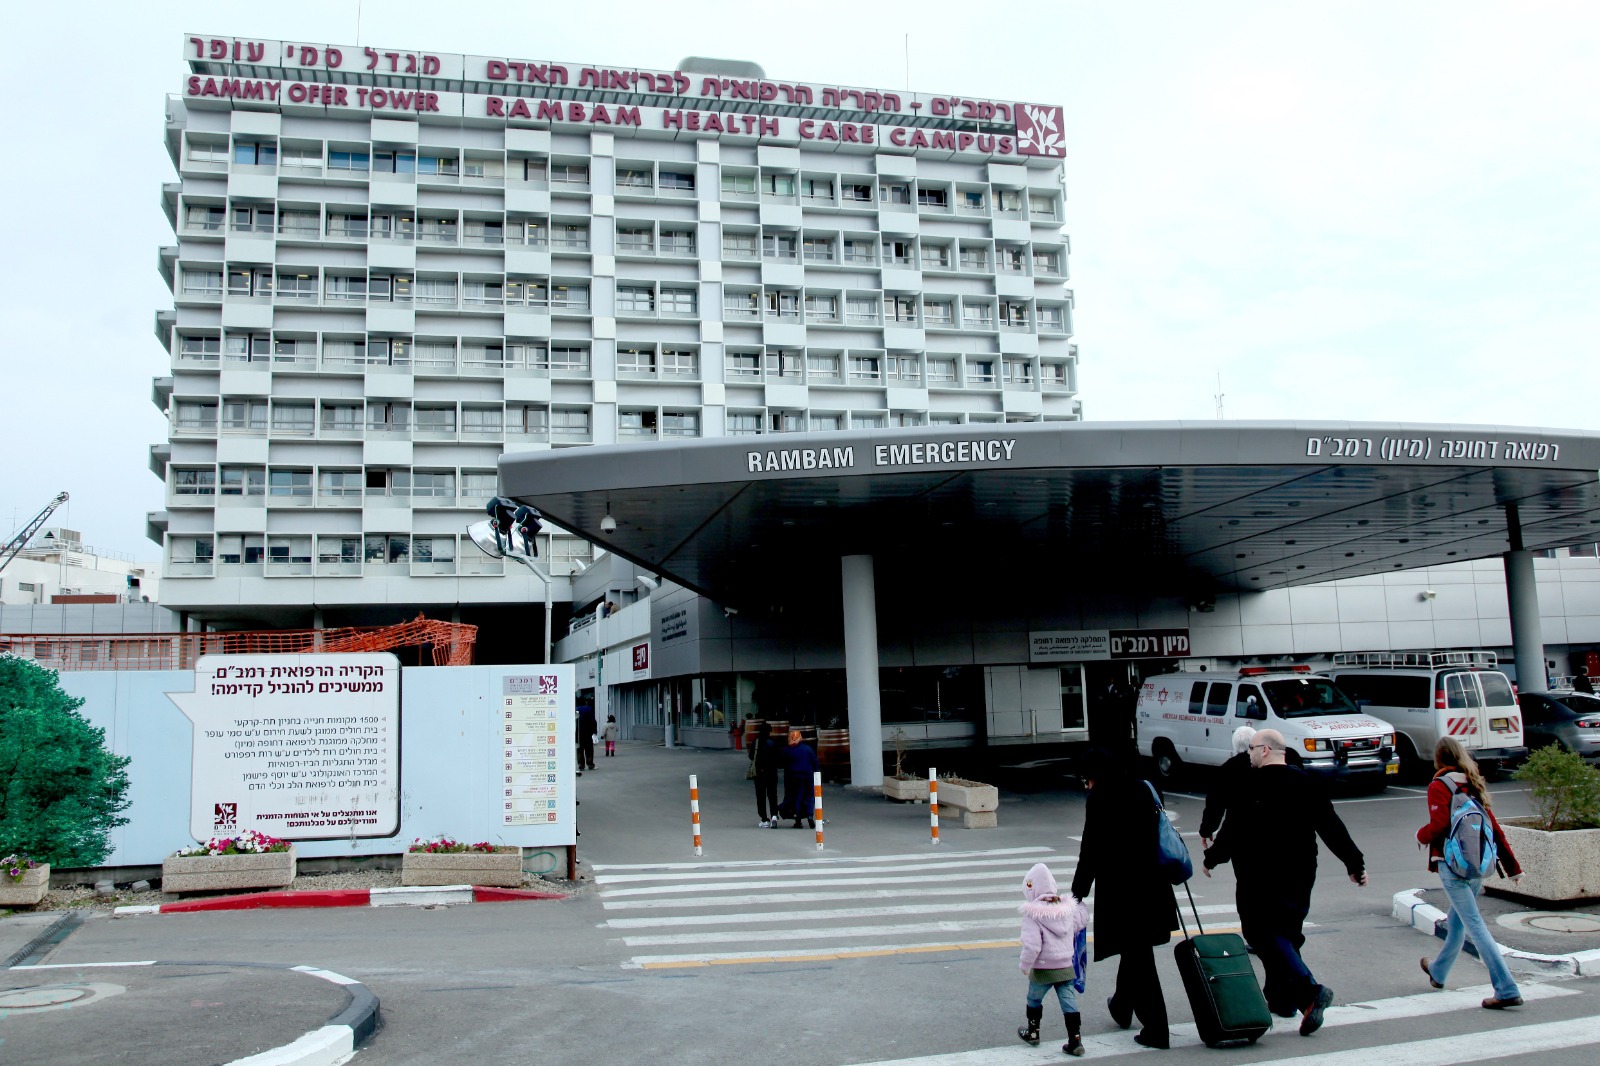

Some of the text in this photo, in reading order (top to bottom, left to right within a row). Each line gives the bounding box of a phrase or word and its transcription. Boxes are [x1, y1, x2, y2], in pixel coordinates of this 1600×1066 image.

[190, 38, 441, 75] מגדל סמי עופר
[487, 60, 568, 85] האדם
[579, 68, 690, 94] לבריאות
[188, 76, 440, 111] SAMMY OFER TOWER
[701, 76, 813, 105] הרפואית
[822, 87, 901, 113] הקריה
[931, 96, 1012, 121] רמב"ם
[486, 96, 1014, 154] RAMBAM HEALTH CARE CAMPUS
[748, 439, 1016, 473] RAMBAM EMERGENCY
[1306, 436, 1559, 461] רפואה דחופה (מיון) רמב"ם
[1111, 635, 1188, 655] מיון רמב"ם
[212, 665, 383, 679] הקריה הרפואית רמב"ם.
[212, 681, 383, 698] ממשיכים להוביל קדימה!
[234, 719, 276, 727] תת-קרקעי
[278, 718, 301, 726] בחניון
[327, 717, 357, 725] מקומות
[288, 727, 311, 735] לשעת
[315, 728, 337, 736] ממוגן
[286, 738, 315, 746] לרפואה
[350, 737, 378, 745] מחלקה
[293, 749, 320, 757] לילדים
[243, 772, 268, 780] פישמן
